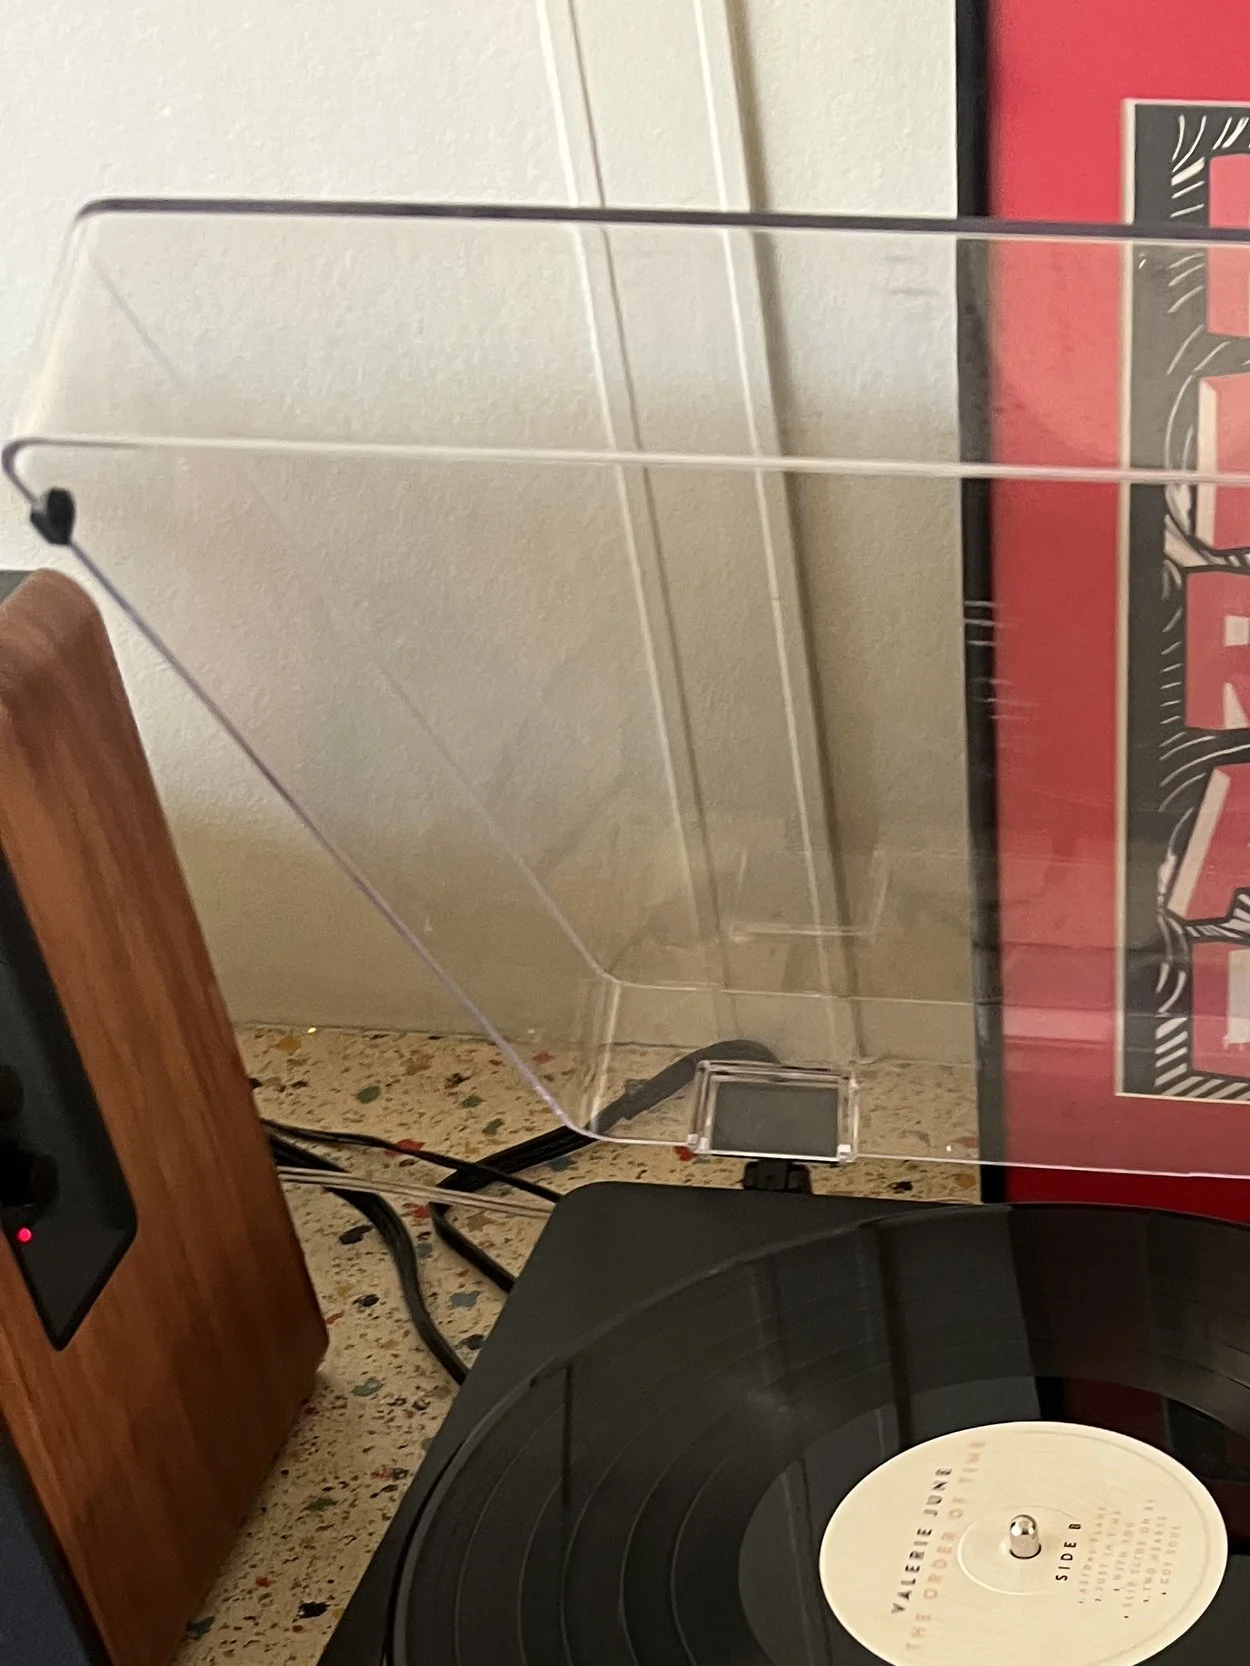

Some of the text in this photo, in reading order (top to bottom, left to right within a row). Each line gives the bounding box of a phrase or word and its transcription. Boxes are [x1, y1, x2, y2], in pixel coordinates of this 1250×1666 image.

[890, 1467, 953, 1615] VALERIE JUNE
[904, 1612, 932, 1651] THE
[923, 1531, 957, 1600] ORDER
[1055, 1541, 1078, 1582] SIDE
